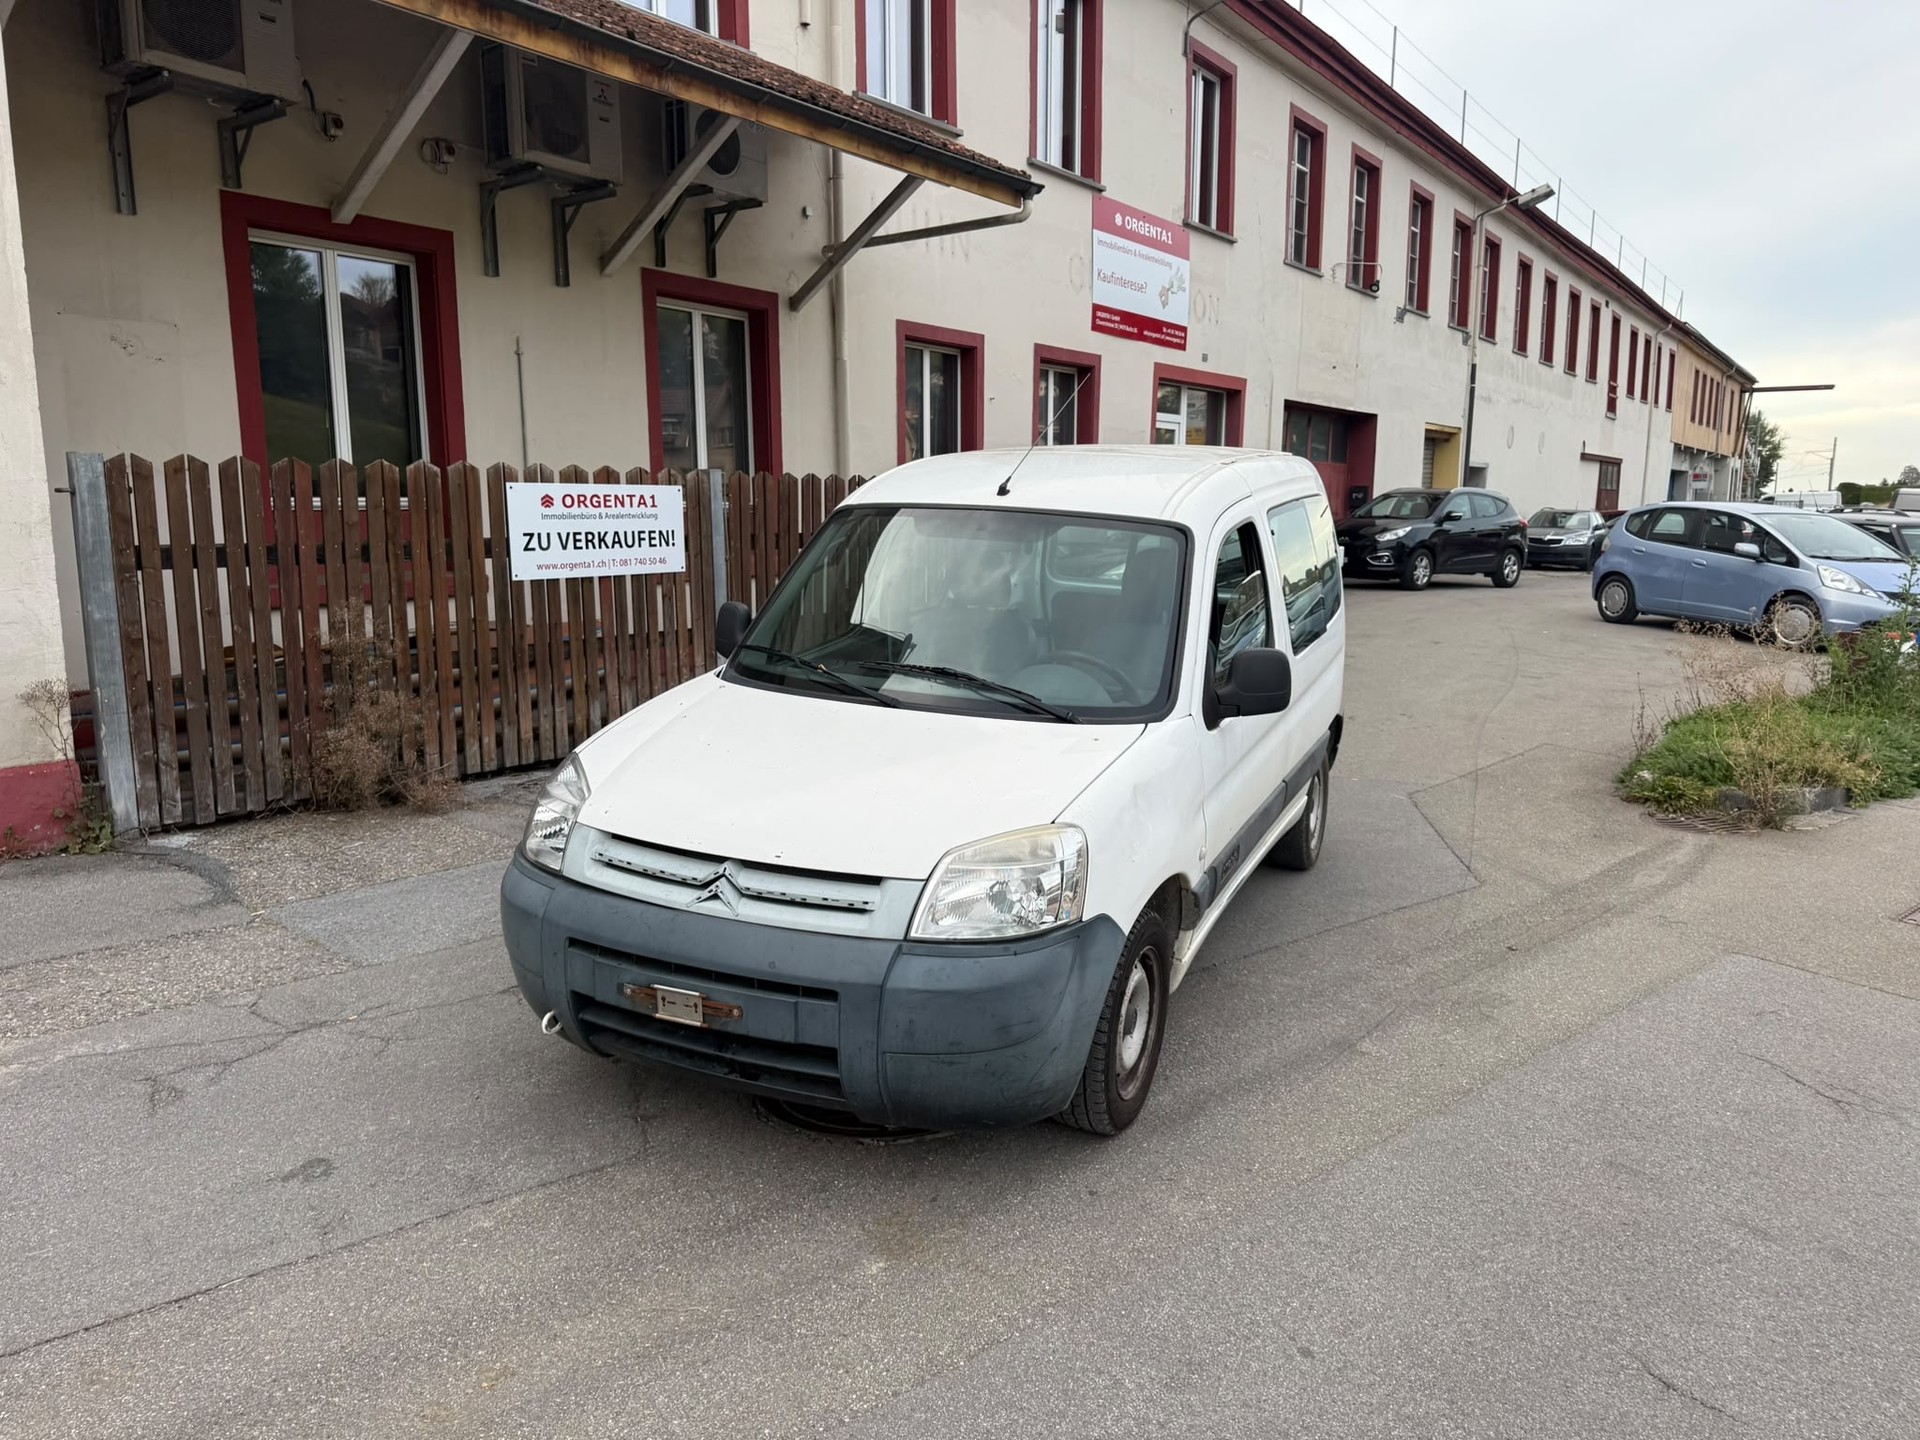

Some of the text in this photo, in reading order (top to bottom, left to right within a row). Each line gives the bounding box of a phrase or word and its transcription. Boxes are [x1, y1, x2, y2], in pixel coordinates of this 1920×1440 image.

[1125, 216, 1173, 245] ORGENTA1
[1097, 267, 1148, 294] Kaufinteresse?
[562, 494, 658, 508] ORGENTA1
[541, 512, 658, 521] Immobilienbüro & Arealentwicklung
[522, 529, 676, 552] ZU VERKAUFEN!
[536, 559, 607, 572] www.orgenta1.ch
[611, 559, 618, 568] T:
[619, 558, 632, 567] 081
[634, 558, 647, 566] 740
[648, 557, 657, 566] 50
[658, 557, 667, 565] 46
